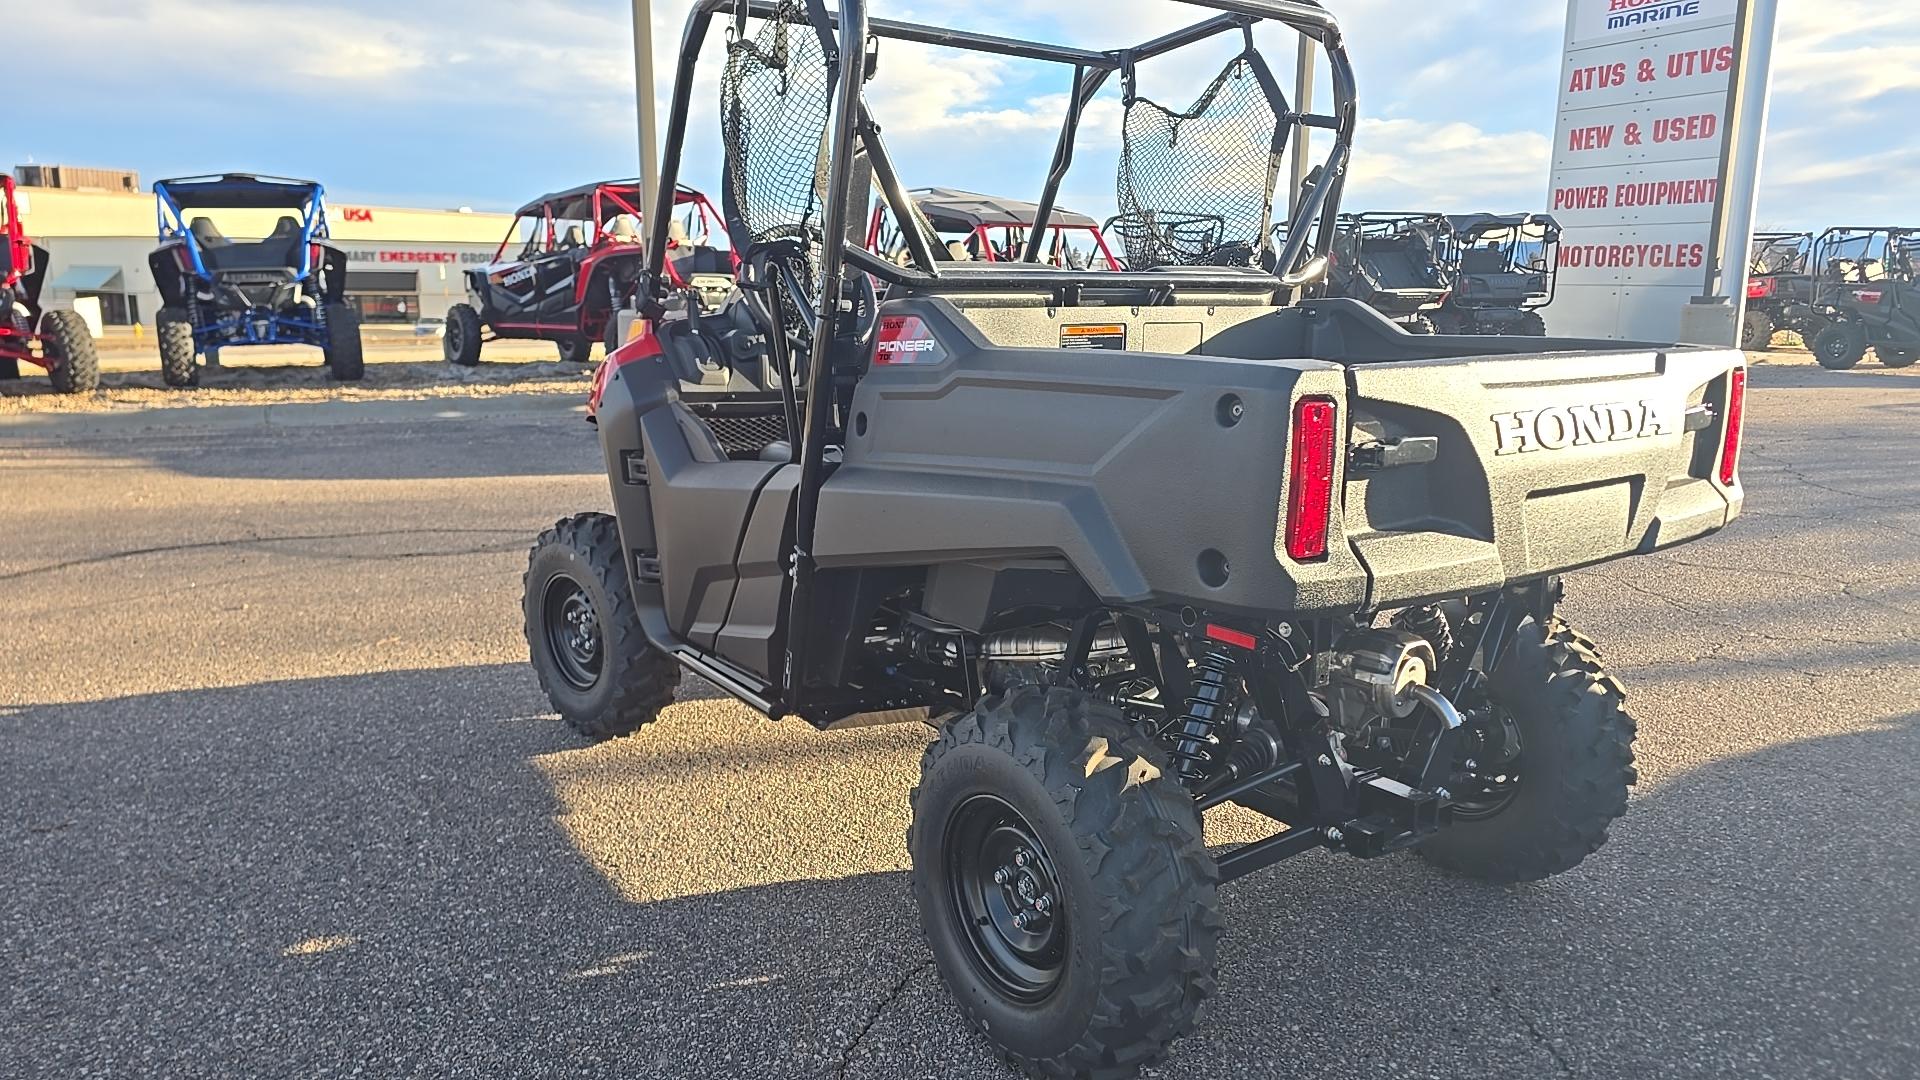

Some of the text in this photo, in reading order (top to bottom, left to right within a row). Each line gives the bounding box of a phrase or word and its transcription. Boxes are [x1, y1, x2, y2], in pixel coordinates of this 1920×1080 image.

[1607, 1, 1700, 29] MARINE
[1568, 46, 1733, 93] ATVS & UTVS
[1569, 113, 1717, 152] NEW & USED
[1554, 178, 1718, 210] POWER EQUIPMENT
[343, 207, 373, 222] USA
[379, 251, 457, 264] EMERGENCY
[1556, 243, 1704, 268] MOTORCYCLES
[877, 340, 935, 353] PIONEER
[1490, 399, 1672, 456] HONDA
